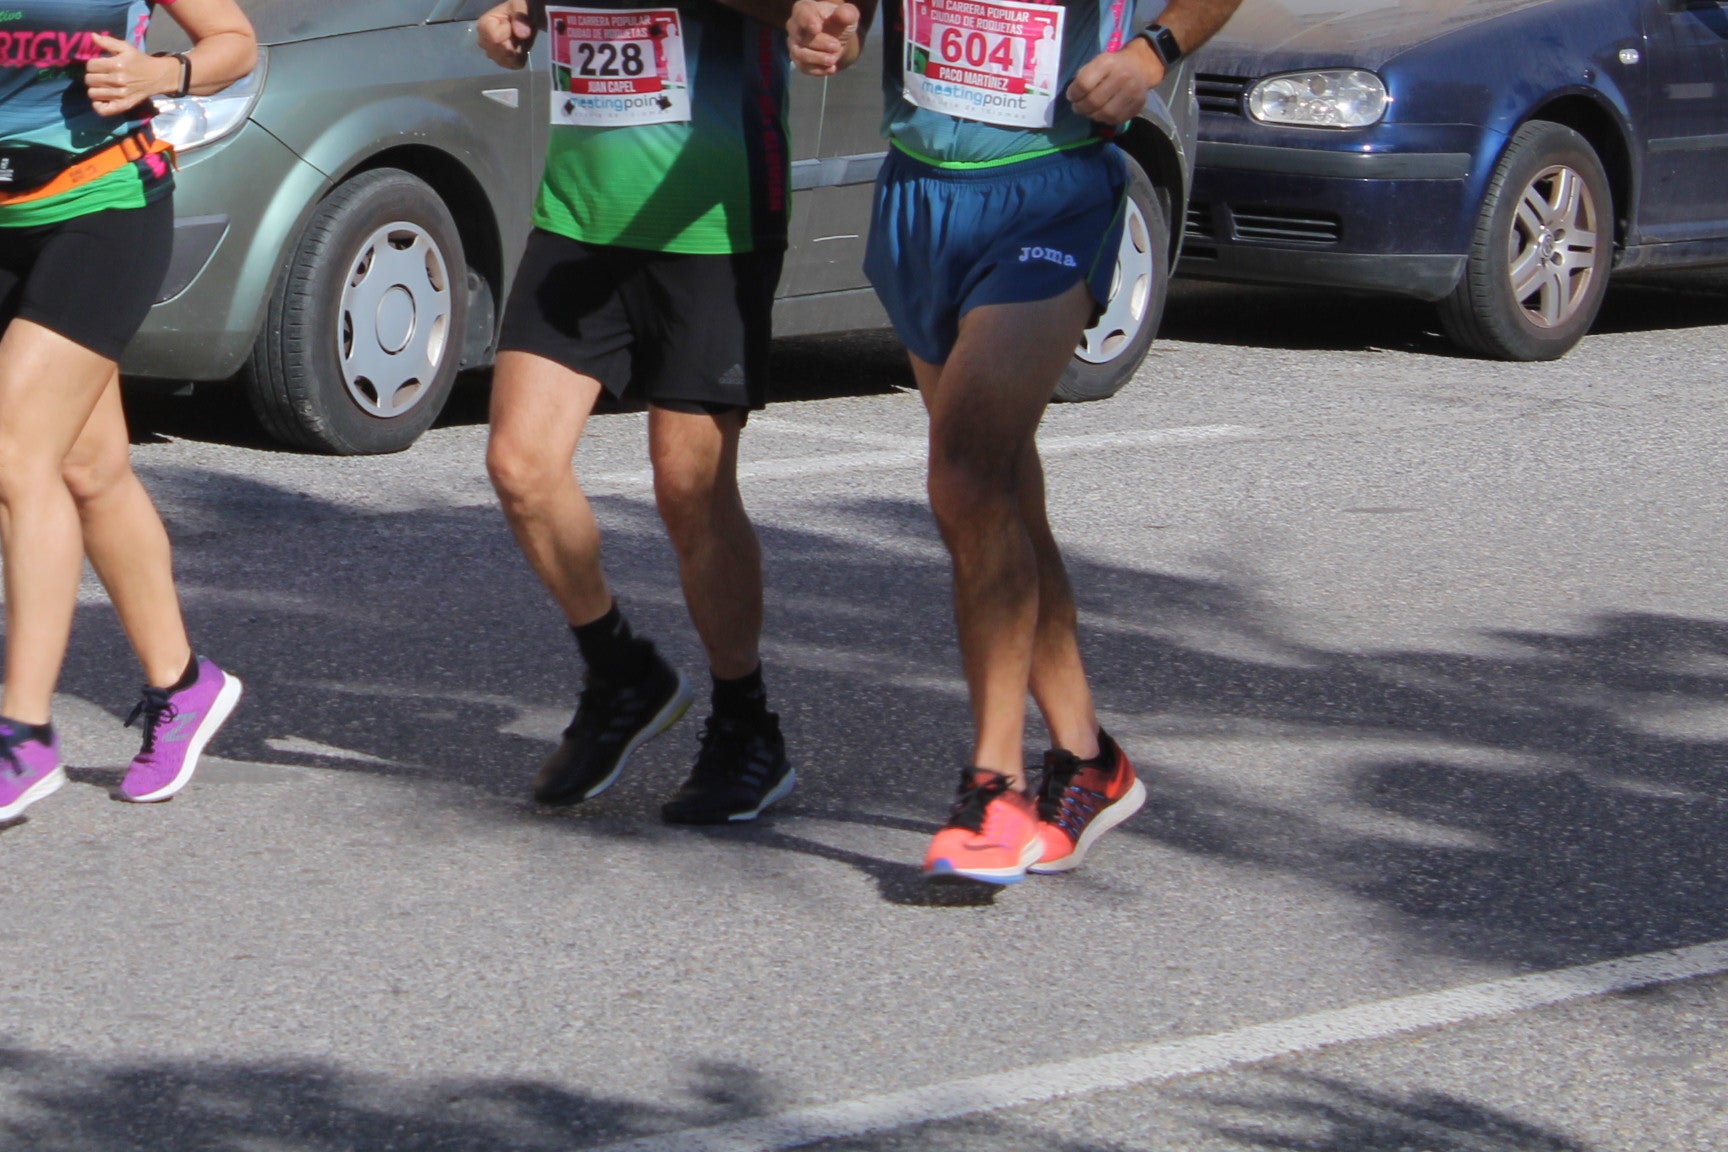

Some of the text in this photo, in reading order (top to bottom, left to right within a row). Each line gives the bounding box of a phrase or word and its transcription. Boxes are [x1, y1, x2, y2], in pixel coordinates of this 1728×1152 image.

[578, 15, 610, 26] CARRERA
[611, 15, 651, 26] POPULAR
[930, 10, 1024, 35] CIUDAD DE ROQUETAS
[946, 0, 986, 16] CARRERA
[987, 7, 1029, 23] POPULAR
[604, 28, 649, 39] ROQUETAS
[578, 42, 644, 76] 228
[940, 28, 1013, 72] 604
[588, 81, 636, 93] JUAN CAPEL
[939, 66, 1009, 91] PACO MARTÍNEZ
